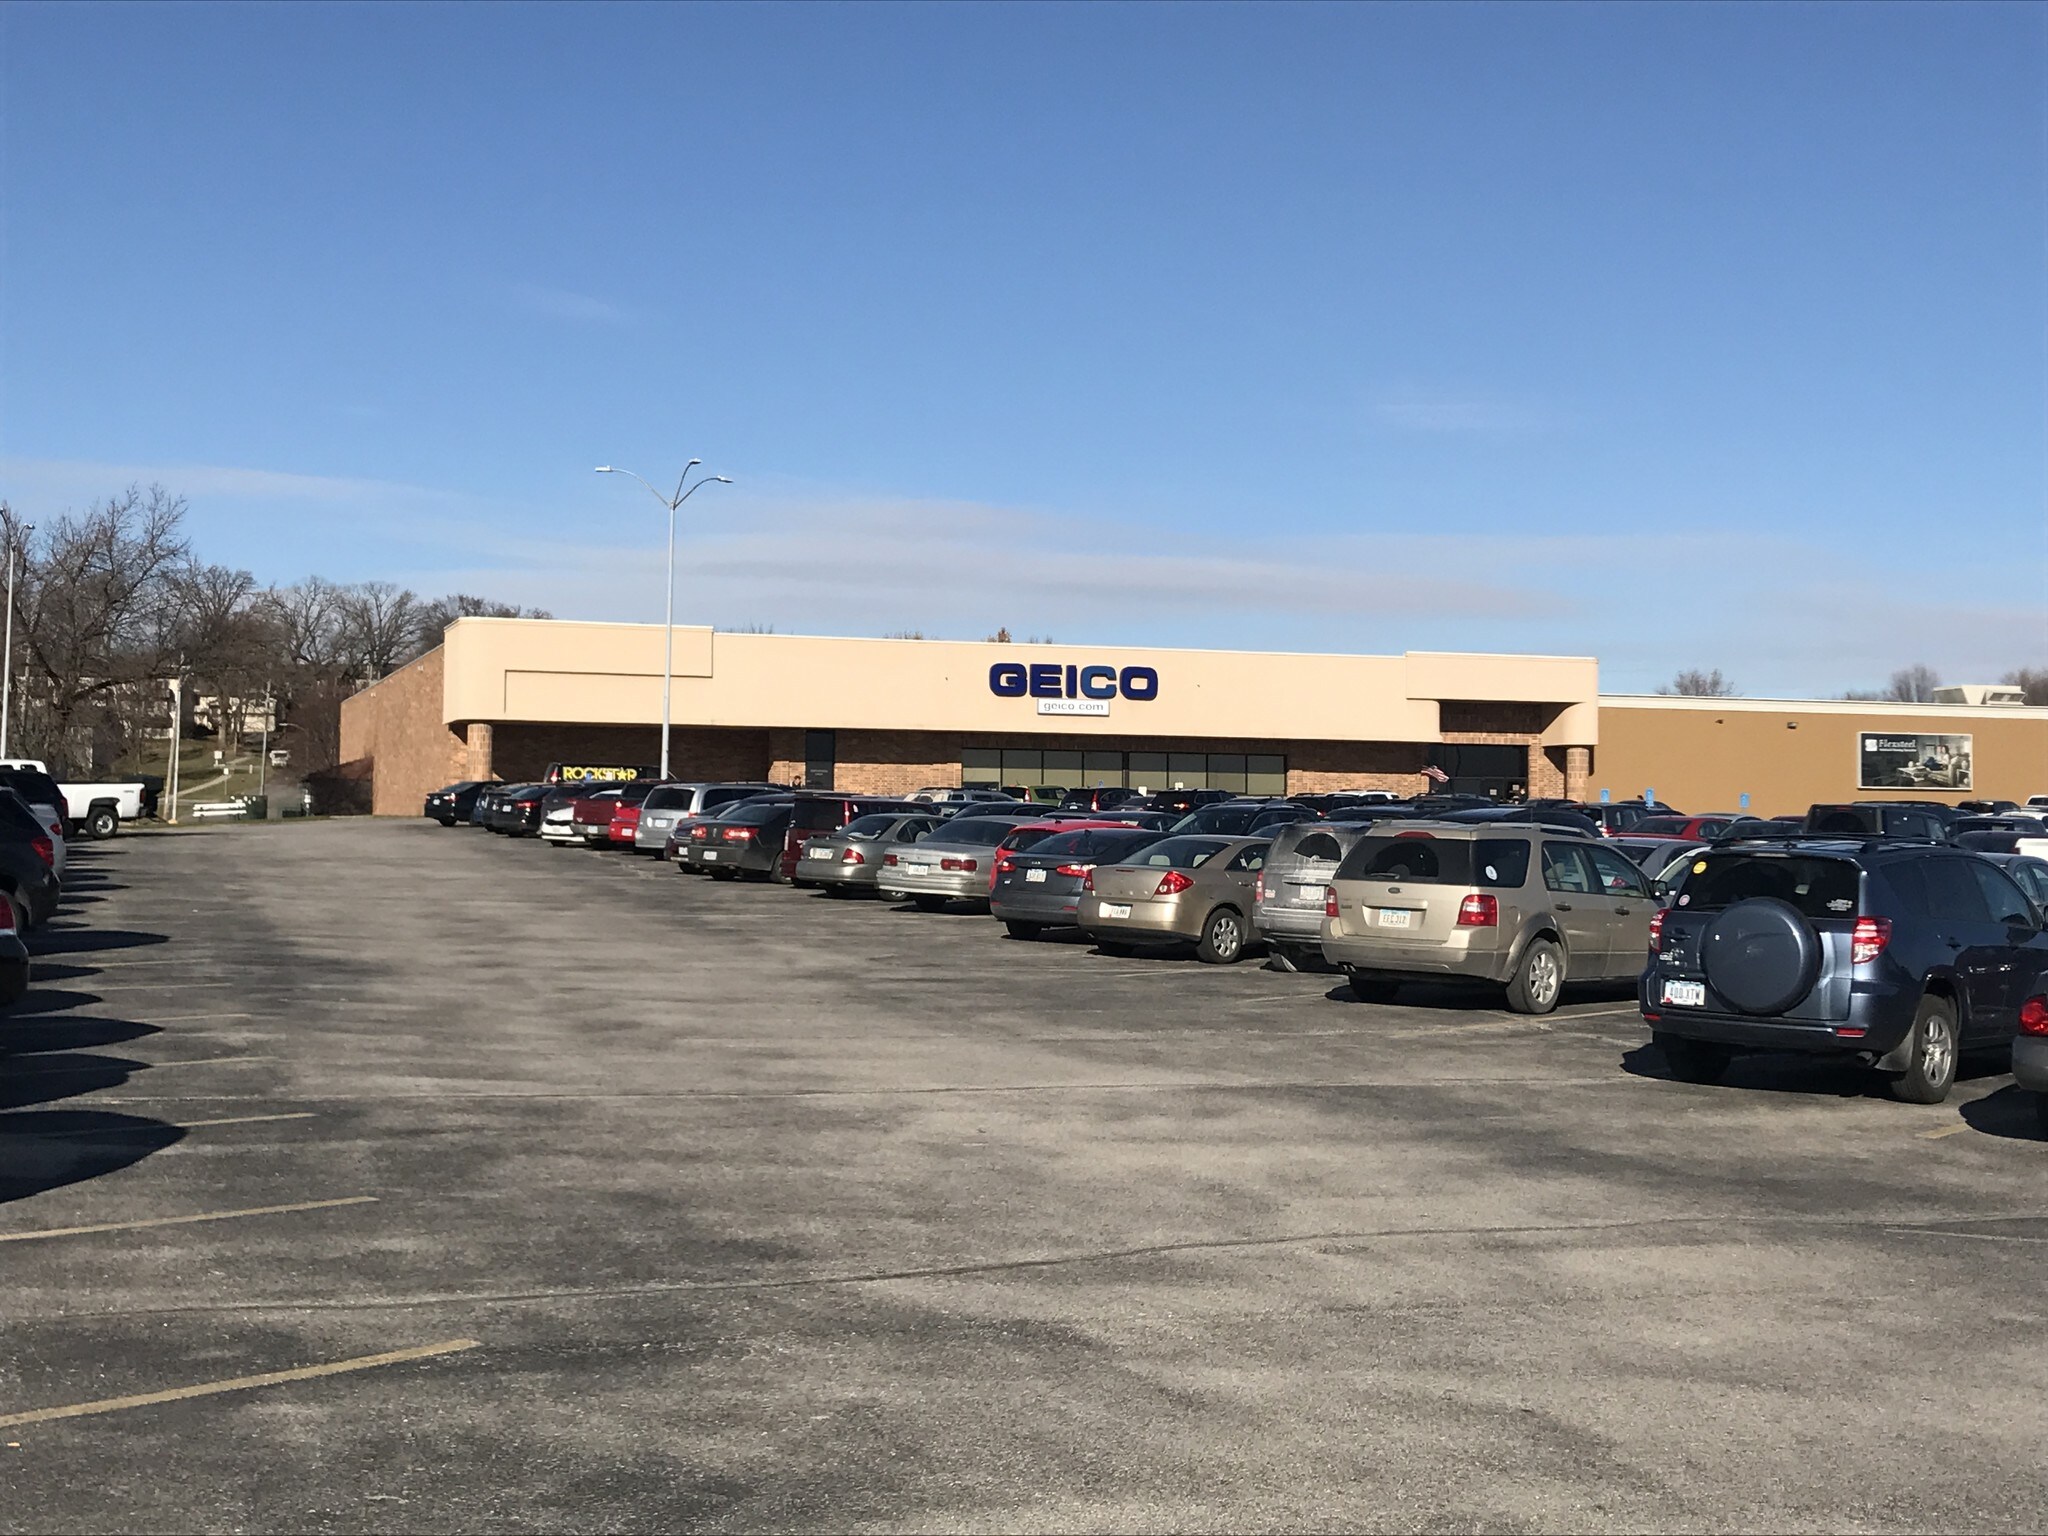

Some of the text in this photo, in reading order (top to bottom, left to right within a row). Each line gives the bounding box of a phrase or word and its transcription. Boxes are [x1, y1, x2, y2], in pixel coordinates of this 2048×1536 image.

[989, 663, 1158, 701] GEICO
[1044, 702, 1104, 711] geicocom
[563, 766, 637, 781] ROCKSTAR
